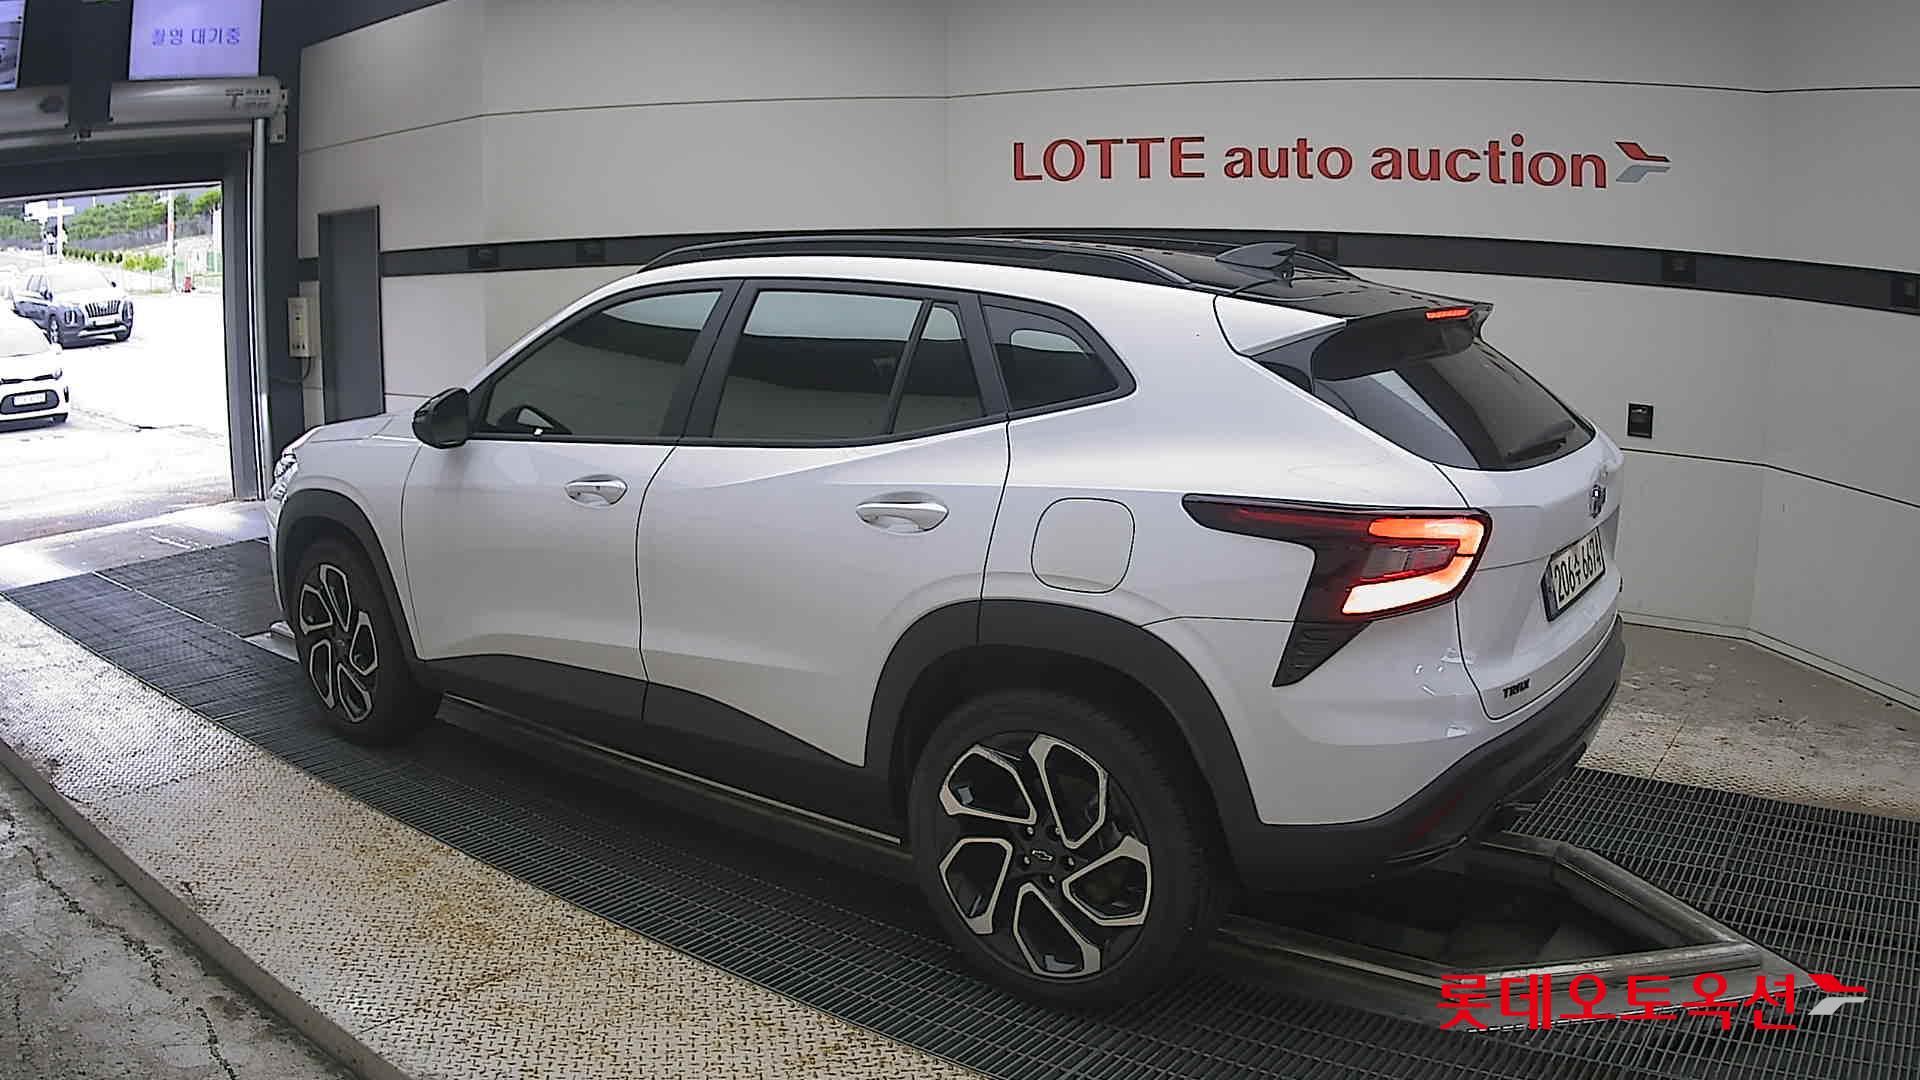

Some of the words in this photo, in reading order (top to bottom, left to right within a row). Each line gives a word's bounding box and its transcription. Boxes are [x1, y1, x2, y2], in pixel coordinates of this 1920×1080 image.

[191, 27, 240, 46] 대기중
[1012, 136, 1206, 182] LOTTE
[1223, 137, 1353, 180] auto
[1370, 133, 1608, 189] auction
